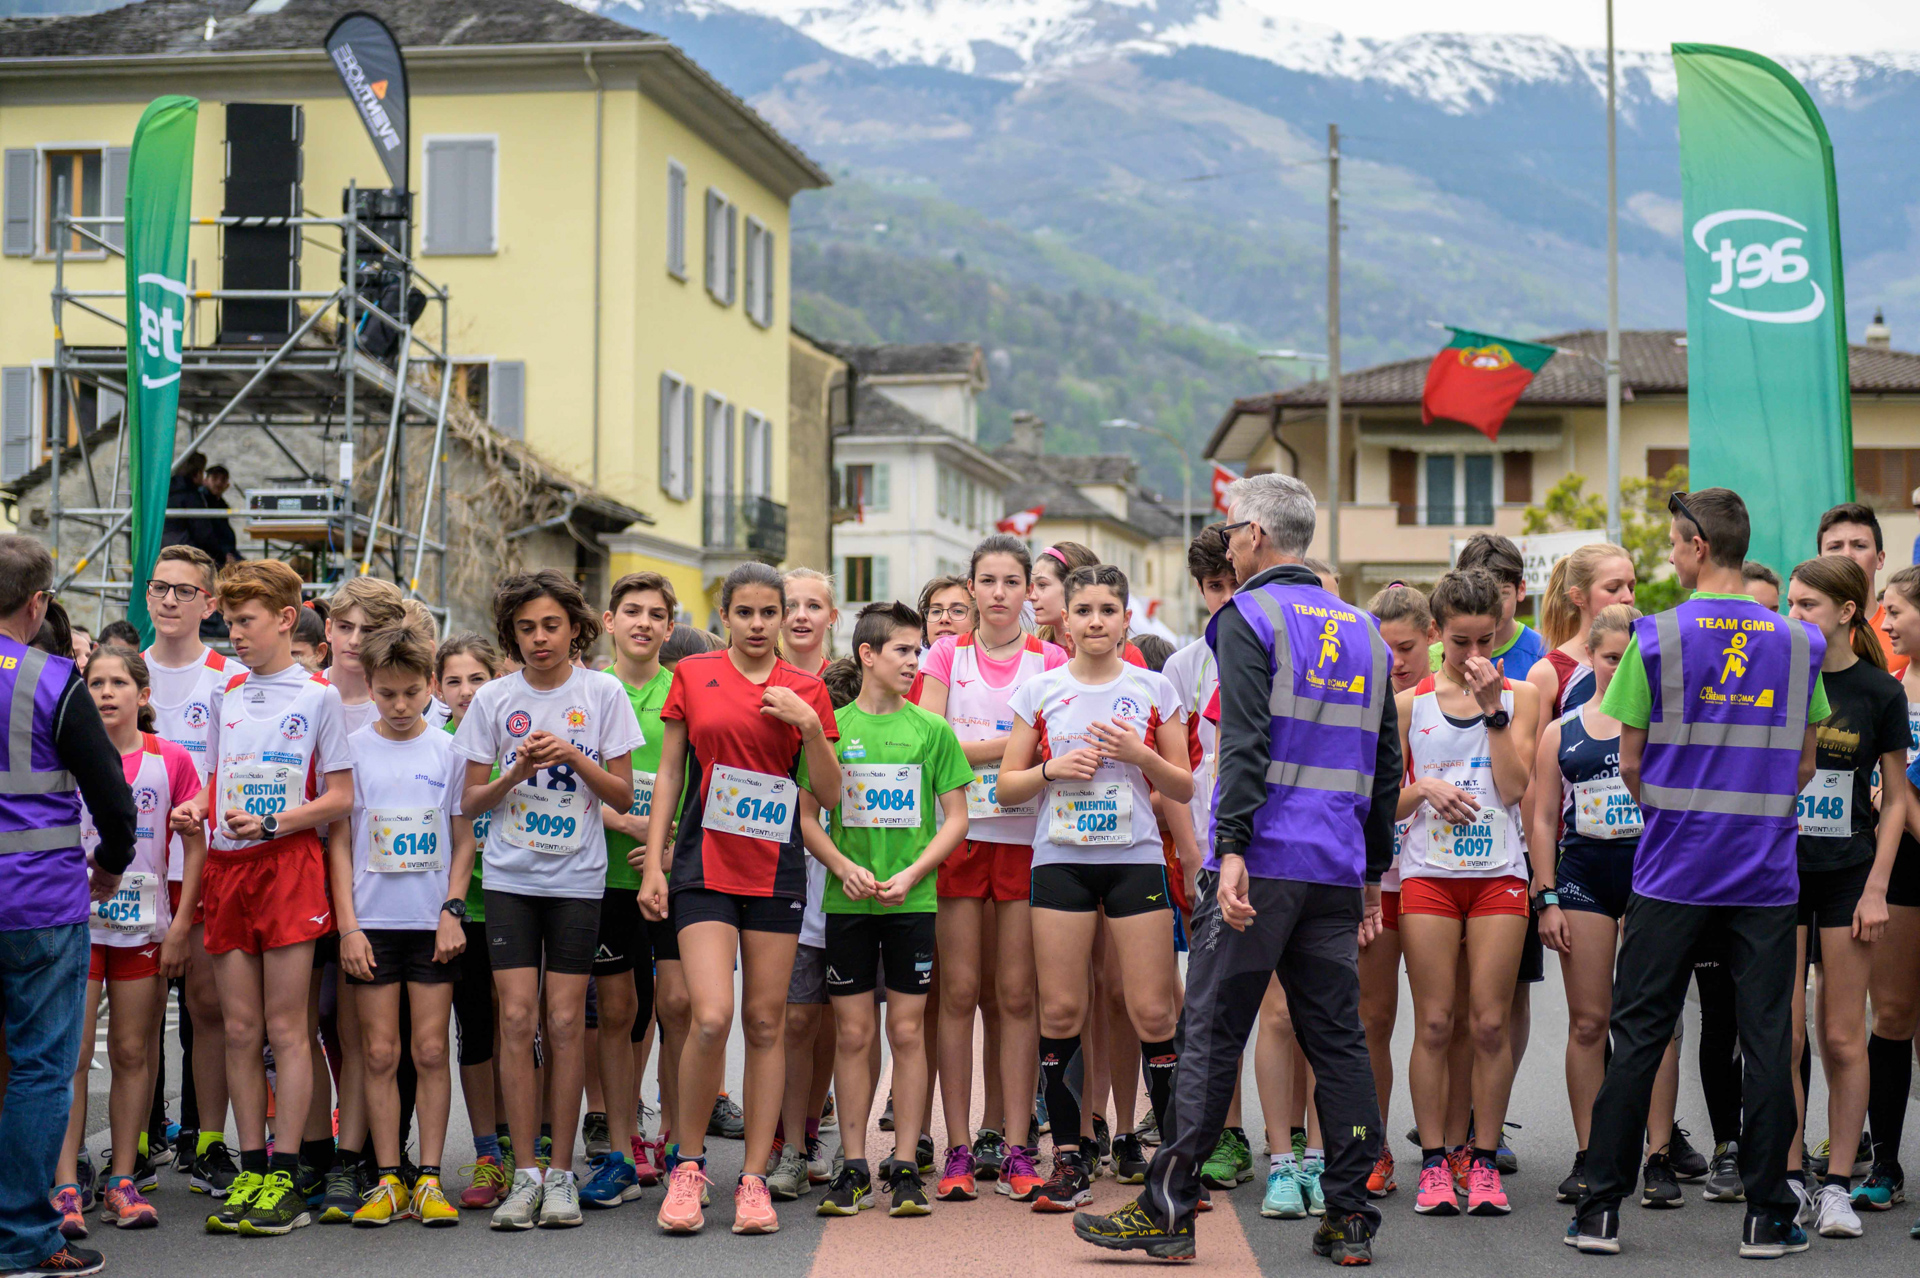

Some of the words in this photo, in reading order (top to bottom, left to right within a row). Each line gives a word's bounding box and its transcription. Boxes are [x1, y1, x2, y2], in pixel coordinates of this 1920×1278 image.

[1293, 603, 1328, 617] TEAM
[1329, 609, 1357, 623] GMB
[1695, 617, 1738, 630] TEAM
[1741, 619, 1775, 632] GMB
[952, 717, 990, 728] MOLINARI
[1423, 761, 1465, 770] MOLINARI
[852, 770, 886, 778] BancoStato
[1825, 776, 1838, 784] aet
[243, 783, 287, 796] CRISTIAN
[726, 774, 762, 787] BancoStato
[773, 782, 785, 791] aet
[516, 788, 549, 802] BancoStato
[865, 788, 915, 811] 9084
[1606, 793, 1637, 807] ANNA
[244, 796, 287, 817] 6092
[736, 796, 787, 825] 6140
[1000, 806, 1035, 814] EVENTMORE
[1074, 800, 1118, 812] VALENTINA
[379, 814, 413, 822] BancoStato
[1077, 813, 1118, 832] 6028
[1605, 806, 1642, 825] 6121
[525, 811, 577, 839] 9099
[1452, 824, 1492, 838] CHIARA
[393, 832, 437, 856] 6149
[1453, 838, 1494, 857] 6097
[97, 901, 141, 922] 6054
